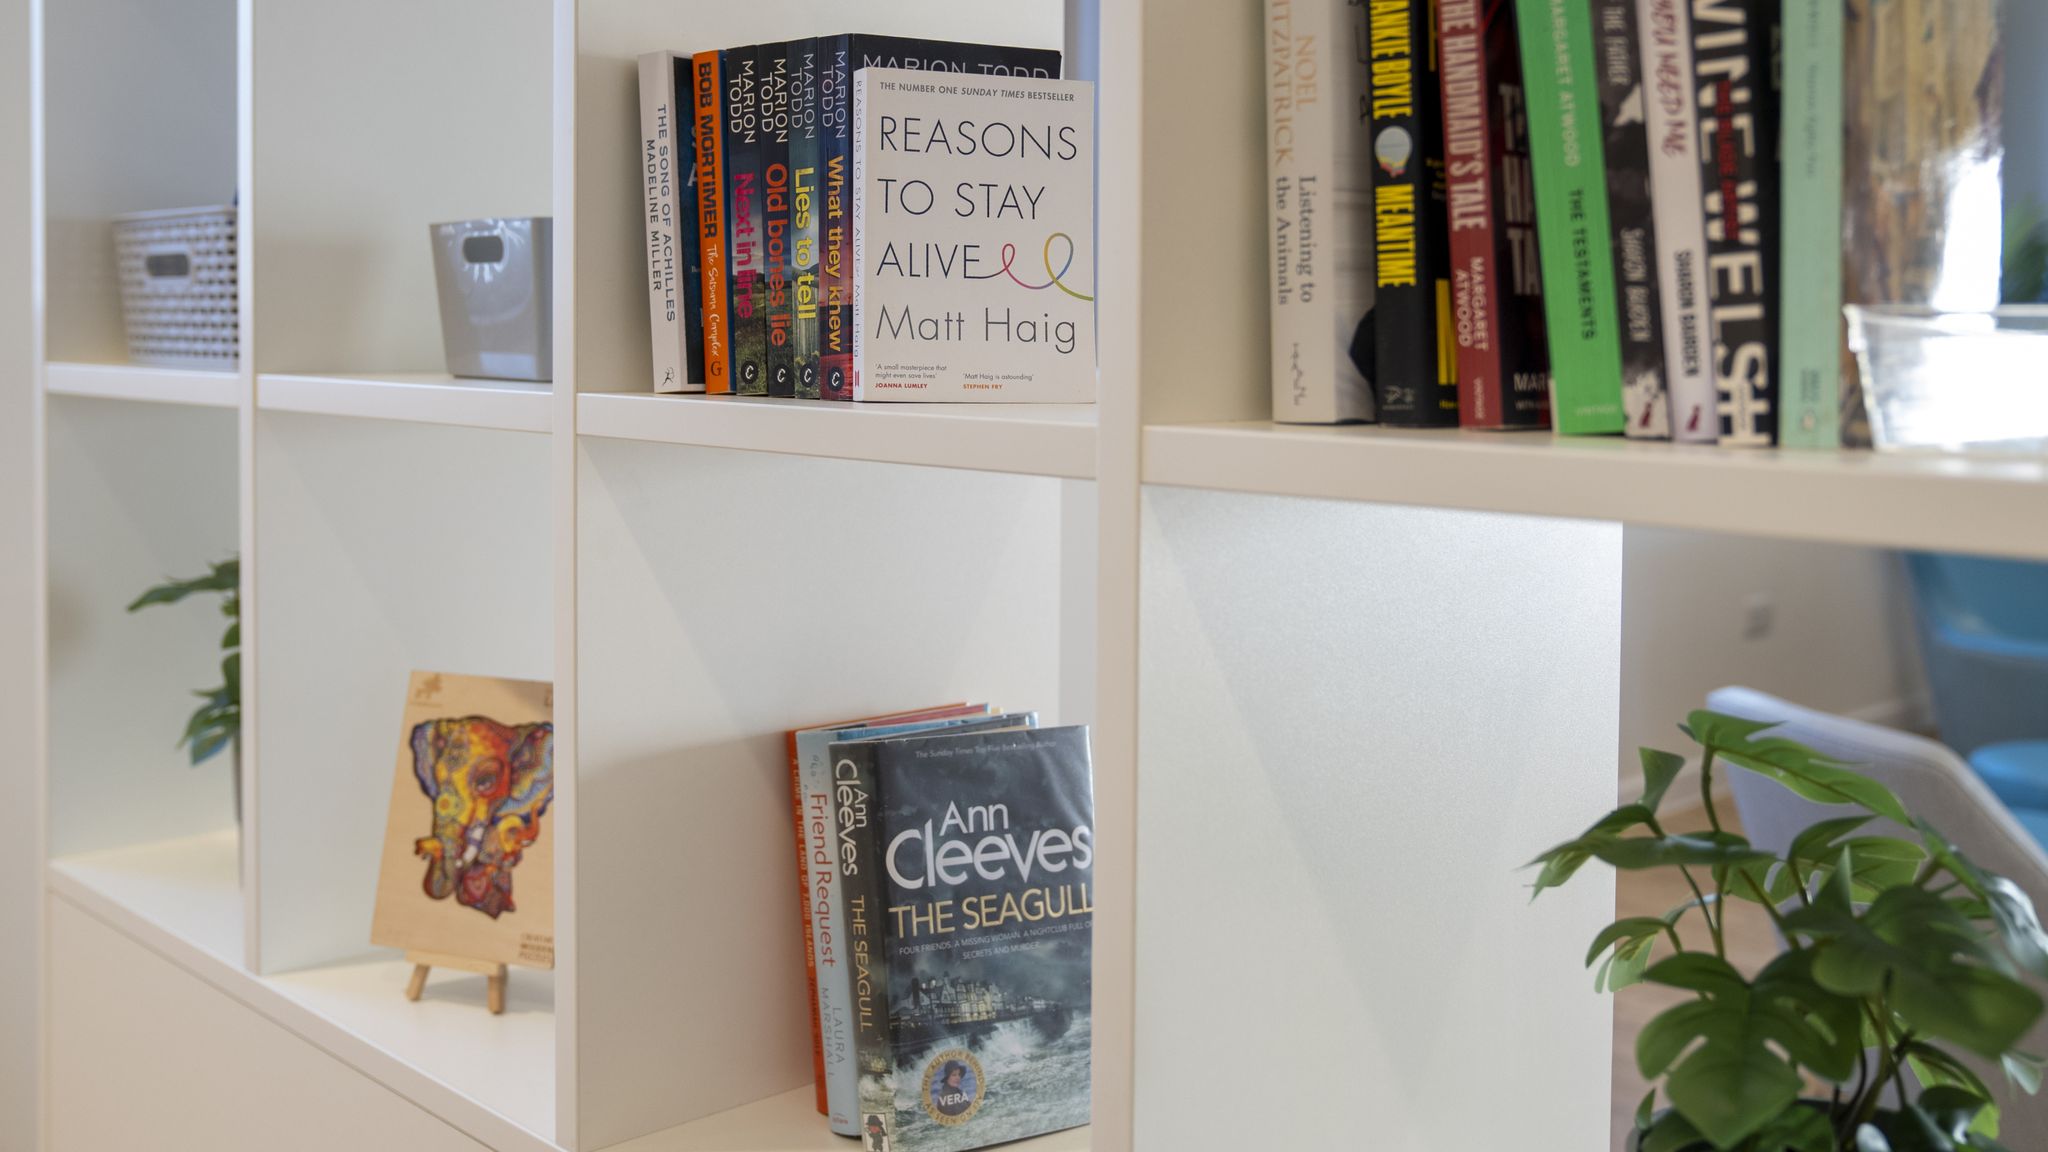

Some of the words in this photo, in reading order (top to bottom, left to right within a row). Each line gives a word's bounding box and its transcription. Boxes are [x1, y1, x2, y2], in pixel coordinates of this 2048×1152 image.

[1604, 6, 1627, 34] THE
[697, 62, 713, 108] BOB
[1296, 34, 1317, 112] NOEL
[1607, 38, 1629, 86] FATHER
[729, 75, 742, 133] TODD
[741, 60, 756, 143] MARION
[761, 73, 774, 132] TODD
[774, 58, 789, 143] MARION
[790, 71, 803, 129] TODD
[802, 53, 816, 139] MARION
[822, 66, 835, 128] TODD
[833, 51, 847, 139] MARION
[855, 80, 863, 152] REASONS
[880, 82, 896, 90] THE
[899, 84, 935, 93] NUMBER
[939, 86, 957, 94] ONE
[961, 87, 997, 97] SUNDAY
[1001, 89, 1025, 98] TIMES
[1028, 91, 1074, 101] BESTSELLER
[1371, 60, 1414, 120] BOYLE
[1442, 33, 1486, 177] HANDMAID'S
[657, 104, 667, 138] THE
[880, 116, 1077, 160] REASONS
[1559, 90, 1580, 167] ATWOOD
[647, 139, 659, 223] MADELINE
[659, 143, 670, 198] SONG
[700, 113, 718, 239] MORTIMER
[765, 163, 789, 212] Old
[826, 155, 844, 220] What
[855, 159, 862, 180] TO
[1276, 177, 1289, 212] the
[661, 203, 671, 227] OF
[734, 171, 755, 236] Next
[794, 167, 815, 229] Lies
[877, 179, 934, 215] TO
[955, 183, 1045, 219] STAY
[1452, 181, 1488, 232] TALE
[1569, 189, 1586, 223] THE
[1298, 176, 1317, 274] Listening
[1376, 183, 1417, 288] MEANTIME
[650, 230, 662, 291] MILLER
[662, 232, 675, 322] ACHILLES
[705, 244, 718, 264] The
[736, 241, 756, 265] in
[767, 220, 791, 315] bones
[795, 237, 814, 269] to
[824, 227, 843, 279] they
[876, 242, 980, 279] ALIVE
[1277, 219, 1293, 305] Animals
[707, 268, 719, 312] Satsuma
[737, 268, 757, 319] line
[797, 274, 817, 320] tell
[1299, 280, 1313, 303] to
[1470, 257, 1490, 352] MARGARET
[1573, 230, 1597, 340] TESTAMENTS
[1674, 250, 1696, 311] SHARON
[770, 320, 792, 346] lie
[828, 284, 842, 352] knew
[876, 305, 965, 341] Matt
[985, 308, 1075, 354] Haig
[1456, 269, 1474, 348] ATWOOD
[1706, 180, 1771, 446] WELSH
[709, 314, 720, 357] Complex
[875, 372, 891, 380] might
[901, 365, 934, 373] masterpiece
[930, 749, 953, 759] Sunday
[794, 769, 803, 800] CRIME
[796, 805, 803, 816] IN
[853, 789, 869, 828] Ann
[797, 820, 805, 839] THE
[810, 794, 833, 865] Friend
[836, 760, 858, 876] Cleeves
[940, 801, 1009, 836] Ann
[799, 844, 808, 870] LAND
[886, 819, 1092, 890] Cleeves
[801, 875, 809, 888] OF
[814, 870, 836, 968] Request
[851, 895, 866, 936] THE
[888, 905, 955, 938] THE
[962, 883, 1094, 929] SEAGULL
[805, 924, 814, 967] ISLANDS
[899, 946, 921, 956] FOUR
[962, 936, 991, 947] MISSING
[1031, 925, 1067, 937] NIGHTCLUB
[1069, 923, 1084, 932] FULL
[963, 949, 992, 960] SECRETS
[994, 946, 1010, 955] AND
[854, 941, 873, 1032] SEAGULL
[822, 986, 836, 1078] MARSHALL
[831, 1008, 846, 1065] LAURA
[939, 1092, 969, 1106] VERA
